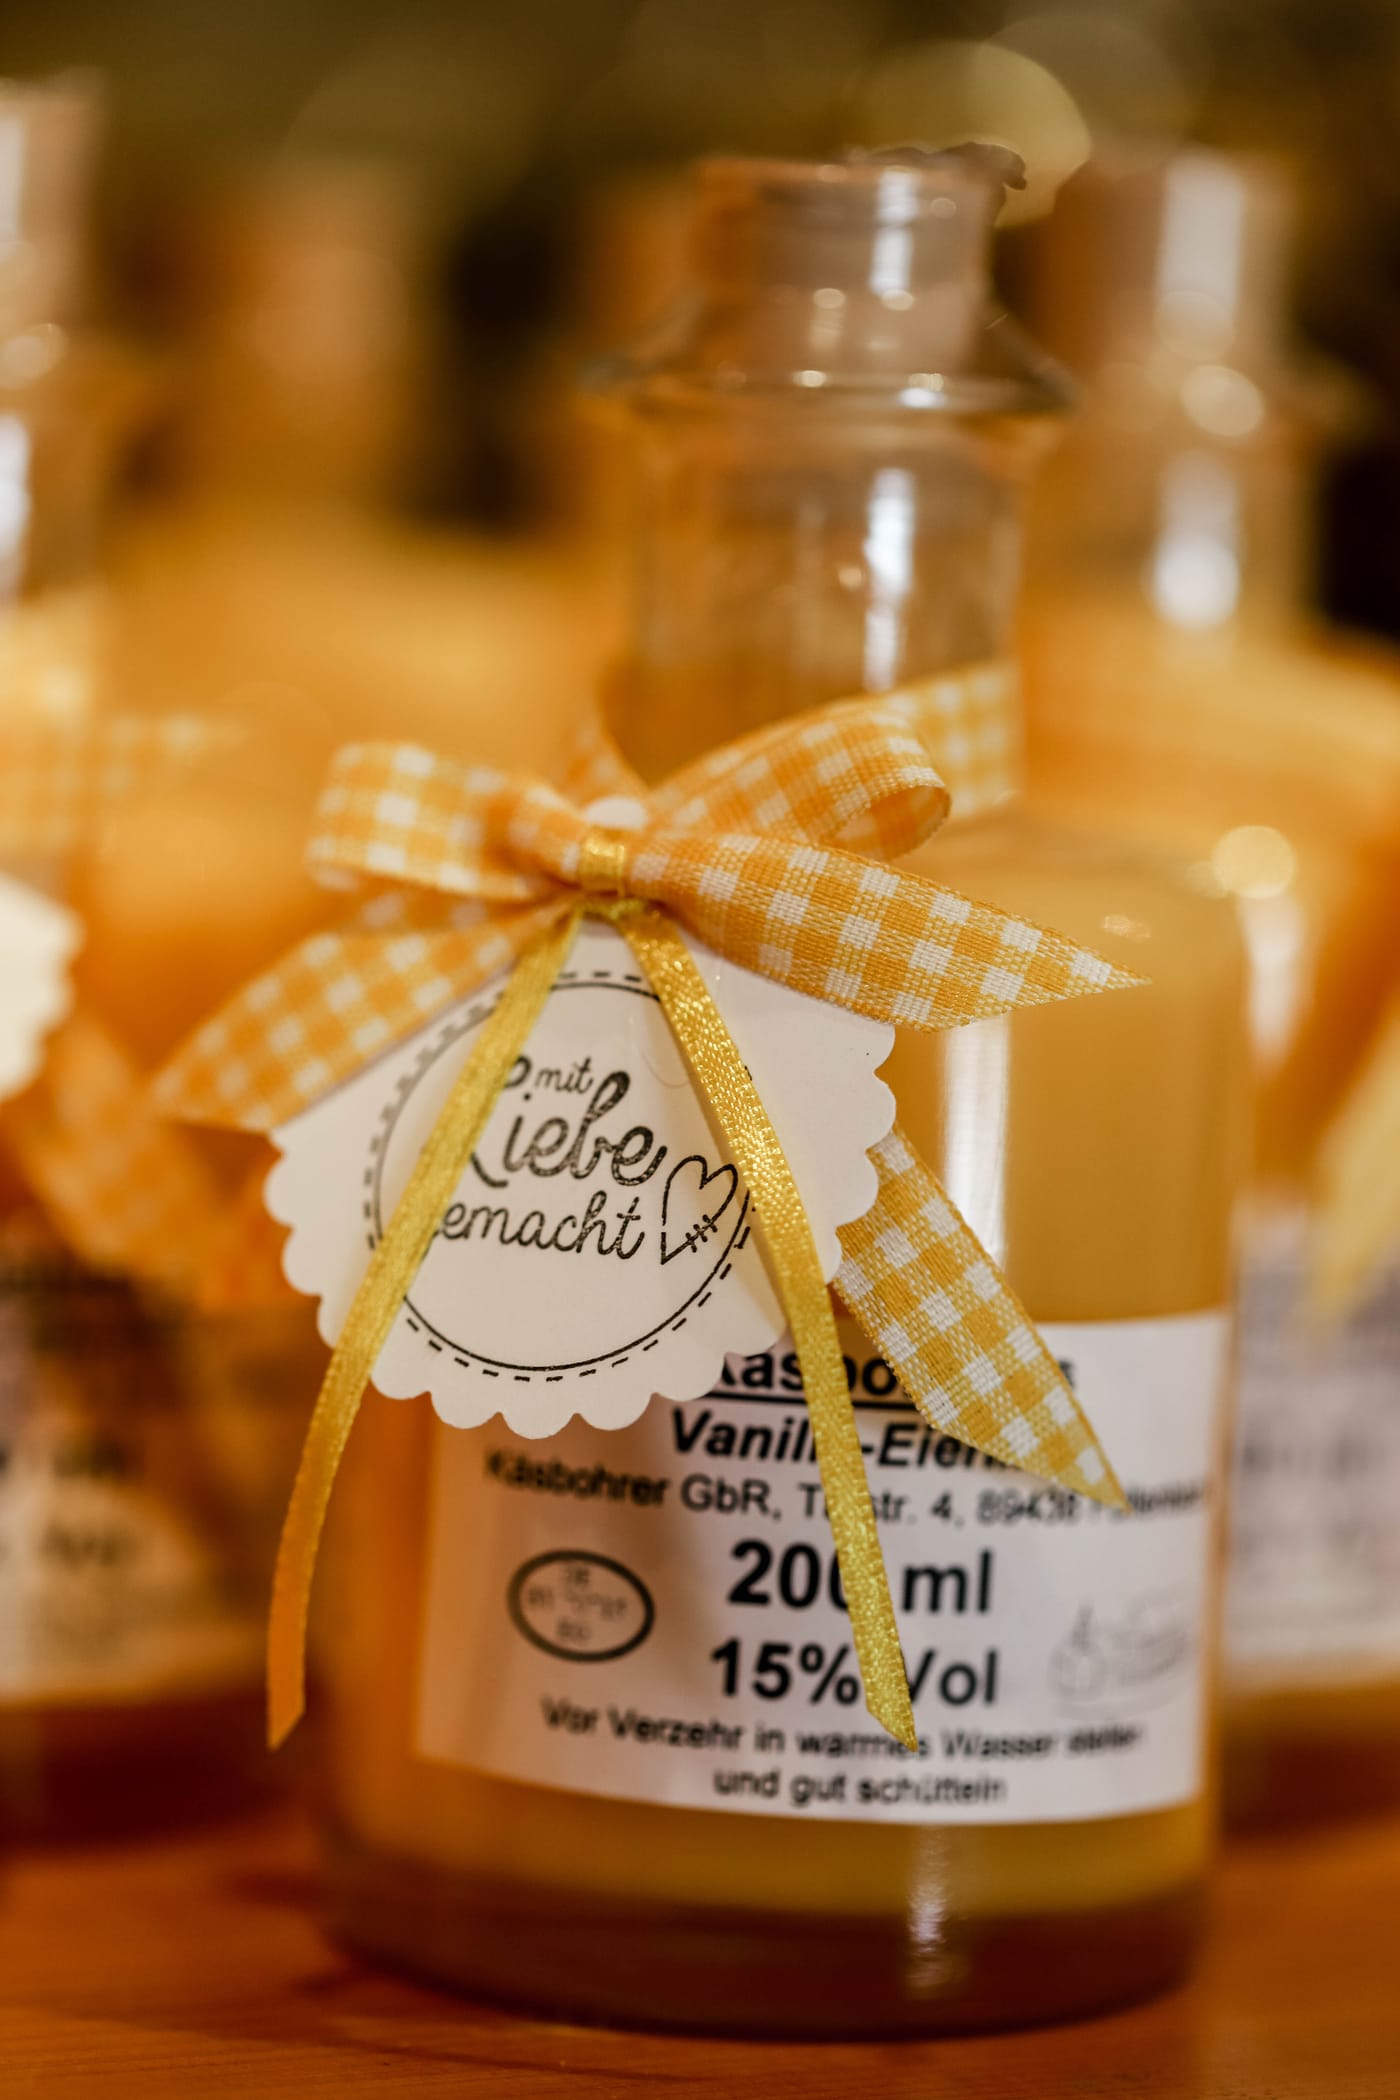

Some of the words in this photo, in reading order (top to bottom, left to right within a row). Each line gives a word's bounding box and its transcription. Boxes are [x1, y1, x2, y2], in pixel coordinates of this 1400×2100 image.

[535, 1056, 595, 1095] mit
[424, 1190, 646, 1260] emacht
[680, 1473, 782, 1522] GbR,
[902, 1547, 993, 1614] ml
[711, 1637, 861, 1706] 15%
[901, 1647, 998, 1706] Vol
[541, 1697, 599, 1736] Vor
[607, 1704, 747, 1751] Verzehr
[754, 1721, 787, 1753] in
[939, 1727, 1053, 1761] Wasser
[713, 1766, 780, 1798] und
[789, 1774, 846, 1808] gut
